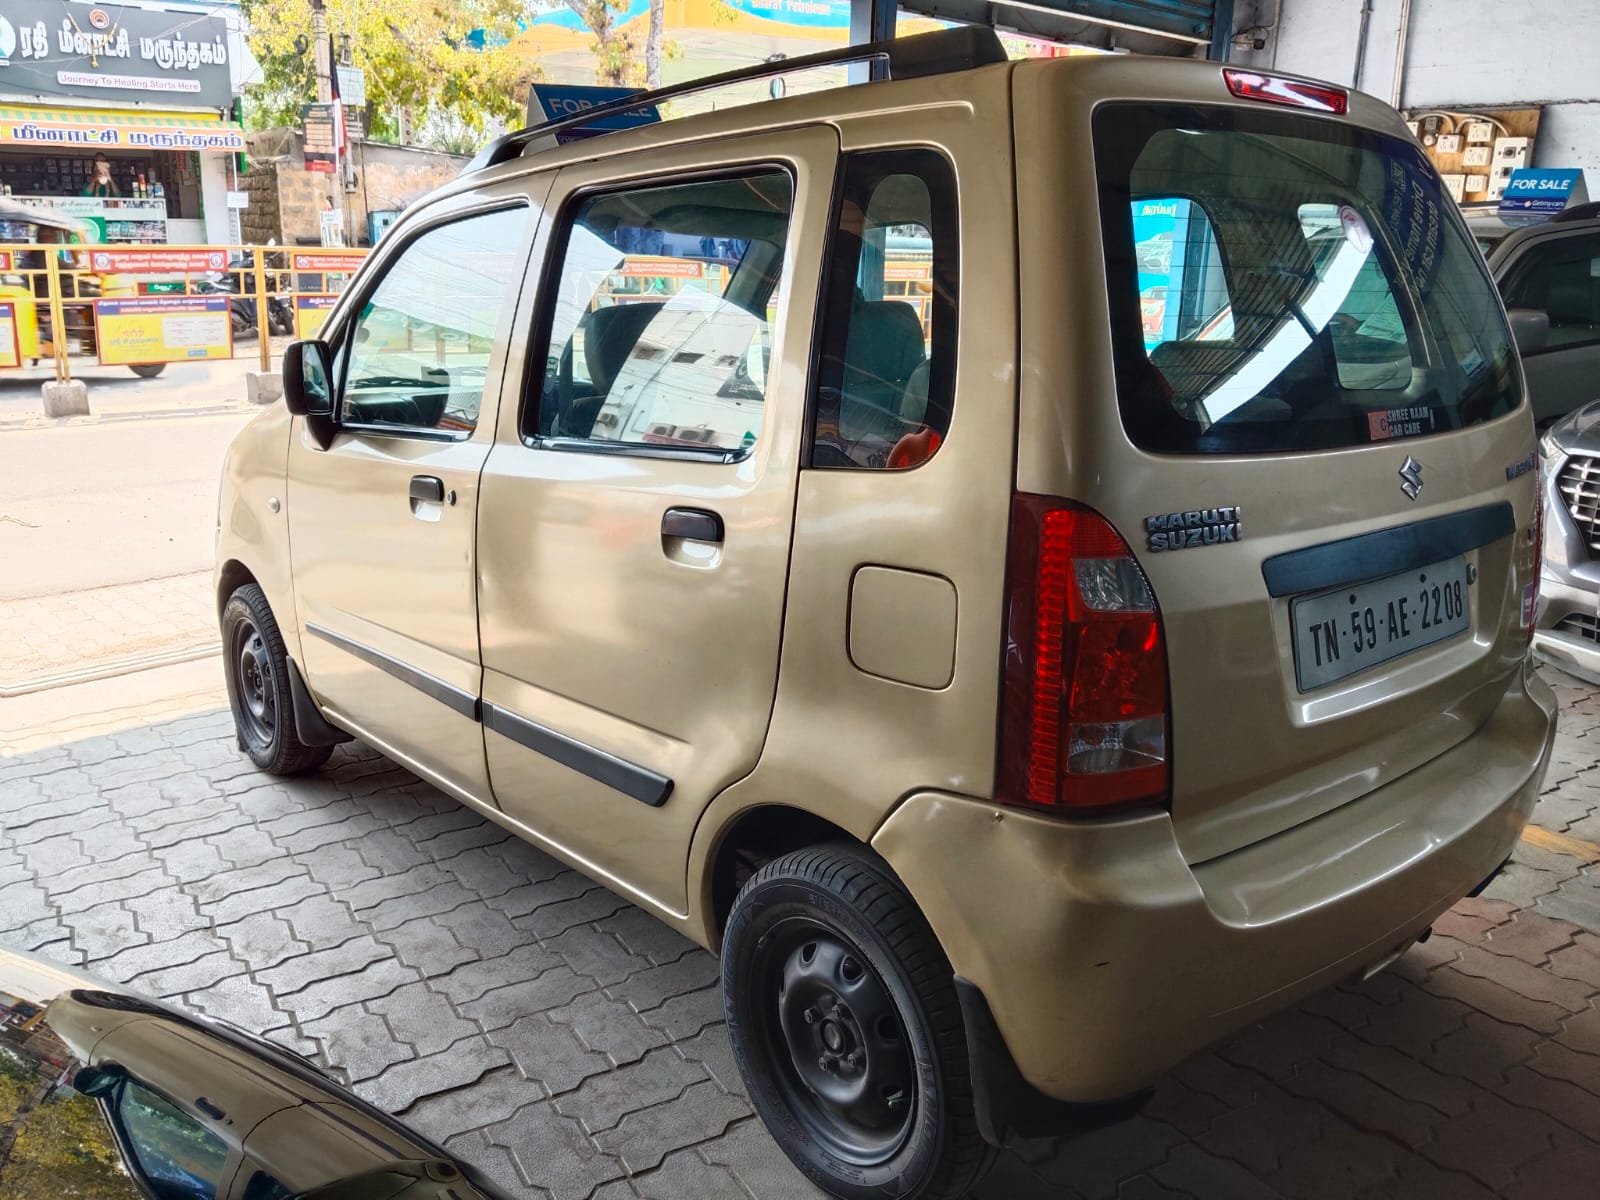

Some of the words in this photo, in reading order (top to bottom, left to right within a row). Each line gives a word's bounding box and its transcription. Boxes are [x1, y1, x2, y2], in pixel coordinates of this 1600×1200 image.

[19, 20, 49, 59] ரதி
[139, 31, 227, 70] மருந்தகம்
[62, 75, 99, 85] Journey
[101, 77, 112, 85] To
[114, 78, 148, 89] Healing
[150, 80, 176, 89] Starts
[178, 81, 199, 90] Here
[12, 123, 119, 144] மீனாட்சி
[128, 130, 242, 148] மருந்தகம்
[1511, 179, 1537, 190] FOR
[1538, 179, 1572, 190] SALE
[1387, 408, 1409, 422] SHREE
[1389, 423, 1403, 437] CAR
[1404, 422, 1421, 435] CARE
[1144, 506, 1241, 532] MARUTI
[1147, 522, 1243, 553] SUZUKI
